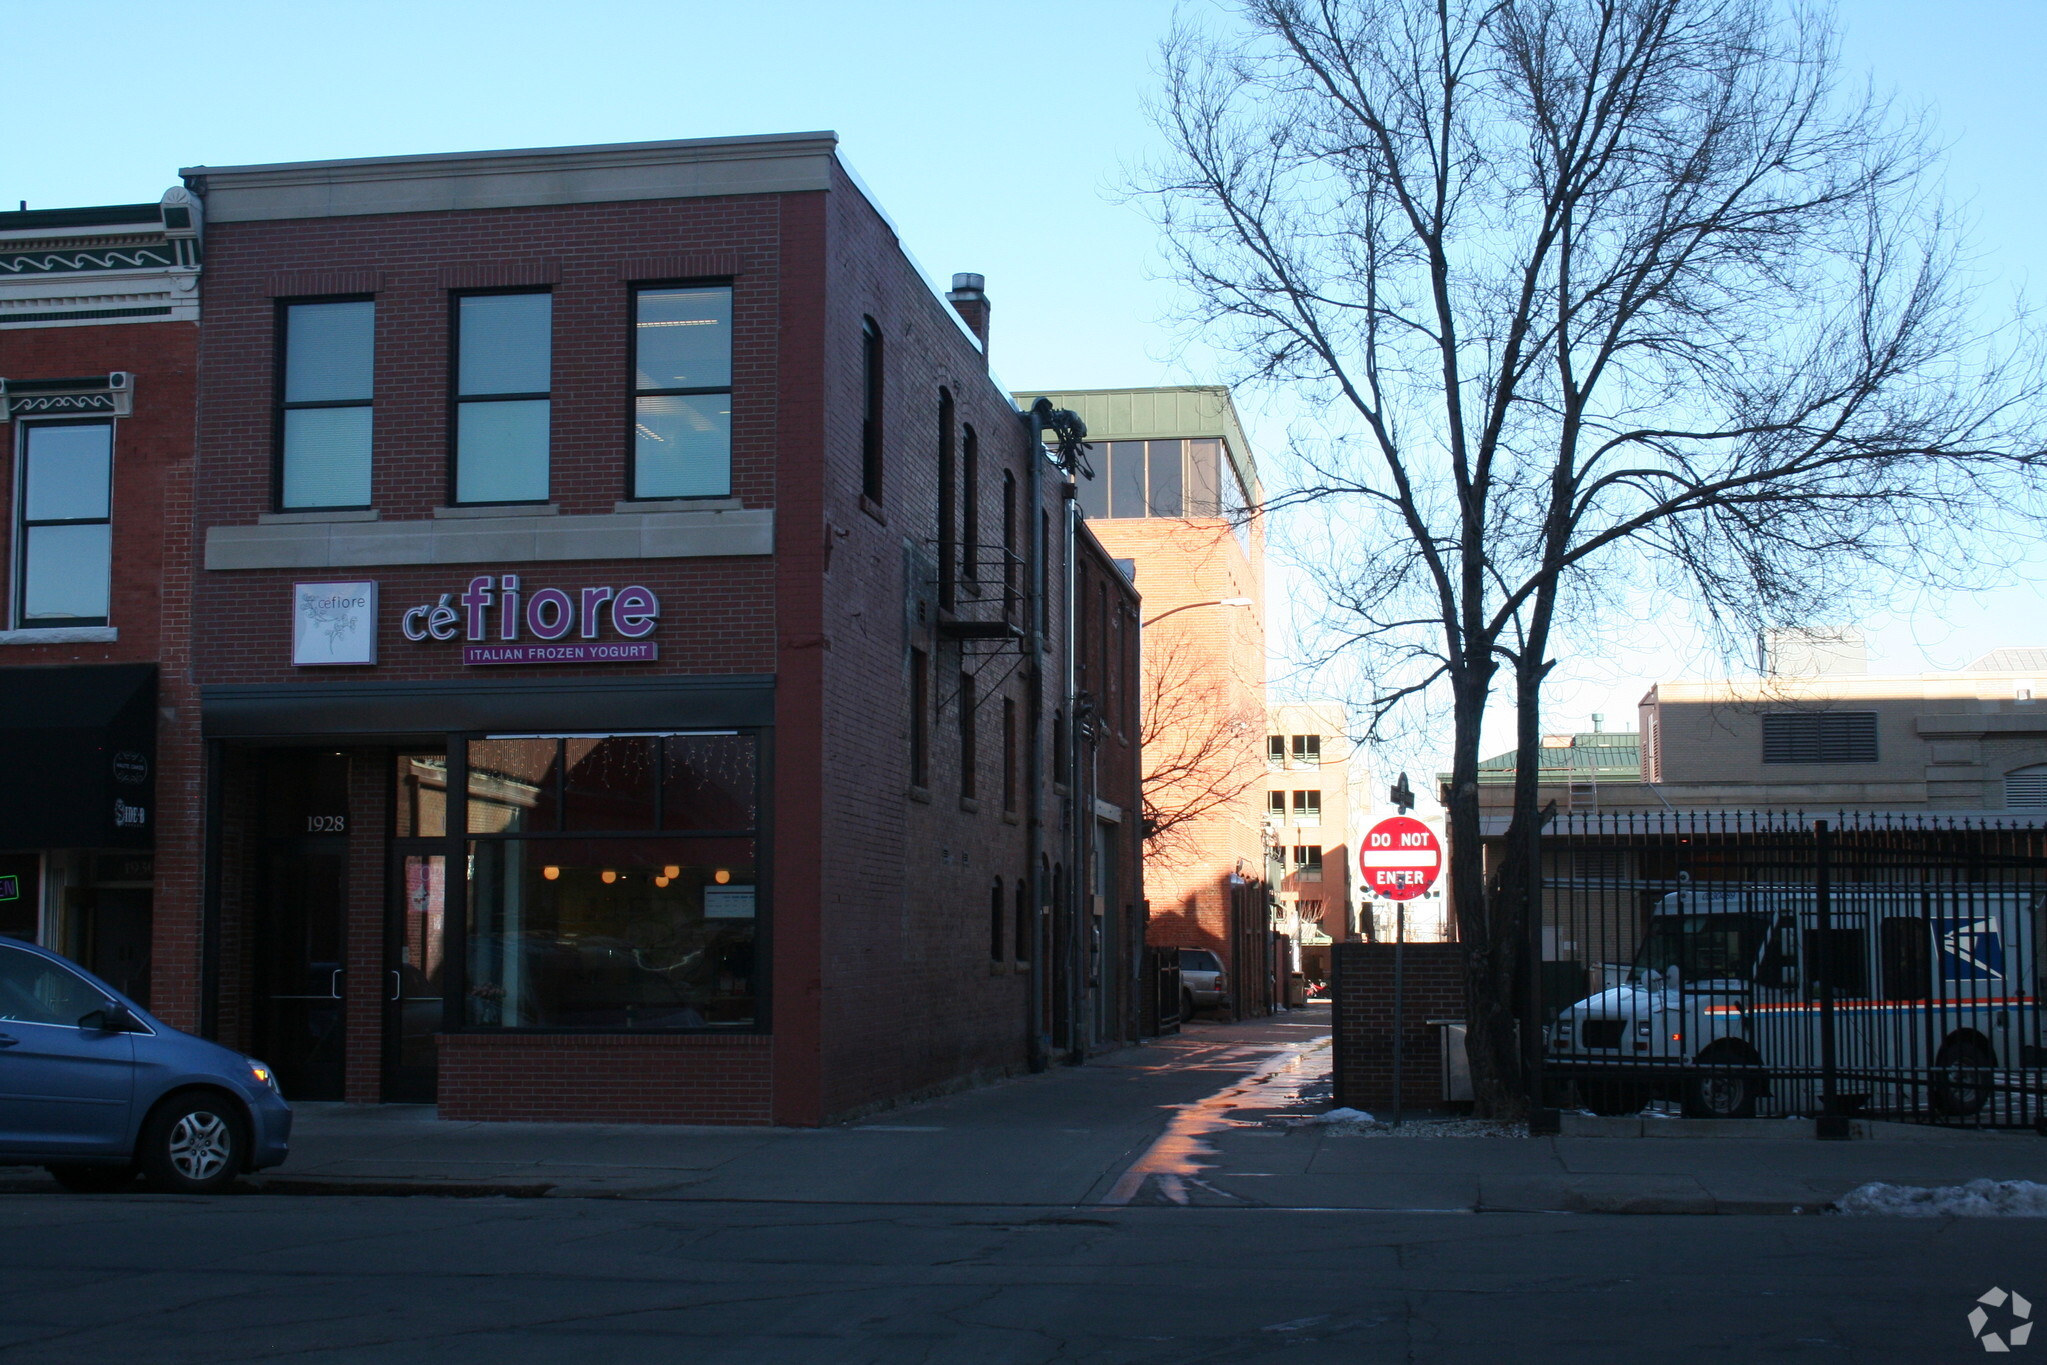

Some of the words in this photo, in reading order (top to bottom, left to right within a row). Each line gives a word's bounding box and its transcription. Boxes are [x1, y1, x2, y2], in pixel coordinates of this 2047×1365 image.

[470, 649, 522, 660] ITALIAN
[529, 648, 584, 659] FROZEN
[590, 646, 647, 657] YOGURT
[307, 815, 344, 832] 1928
[1371, 833, 1391, 847] DO
[1401, 832, 1429, 847] NOT
